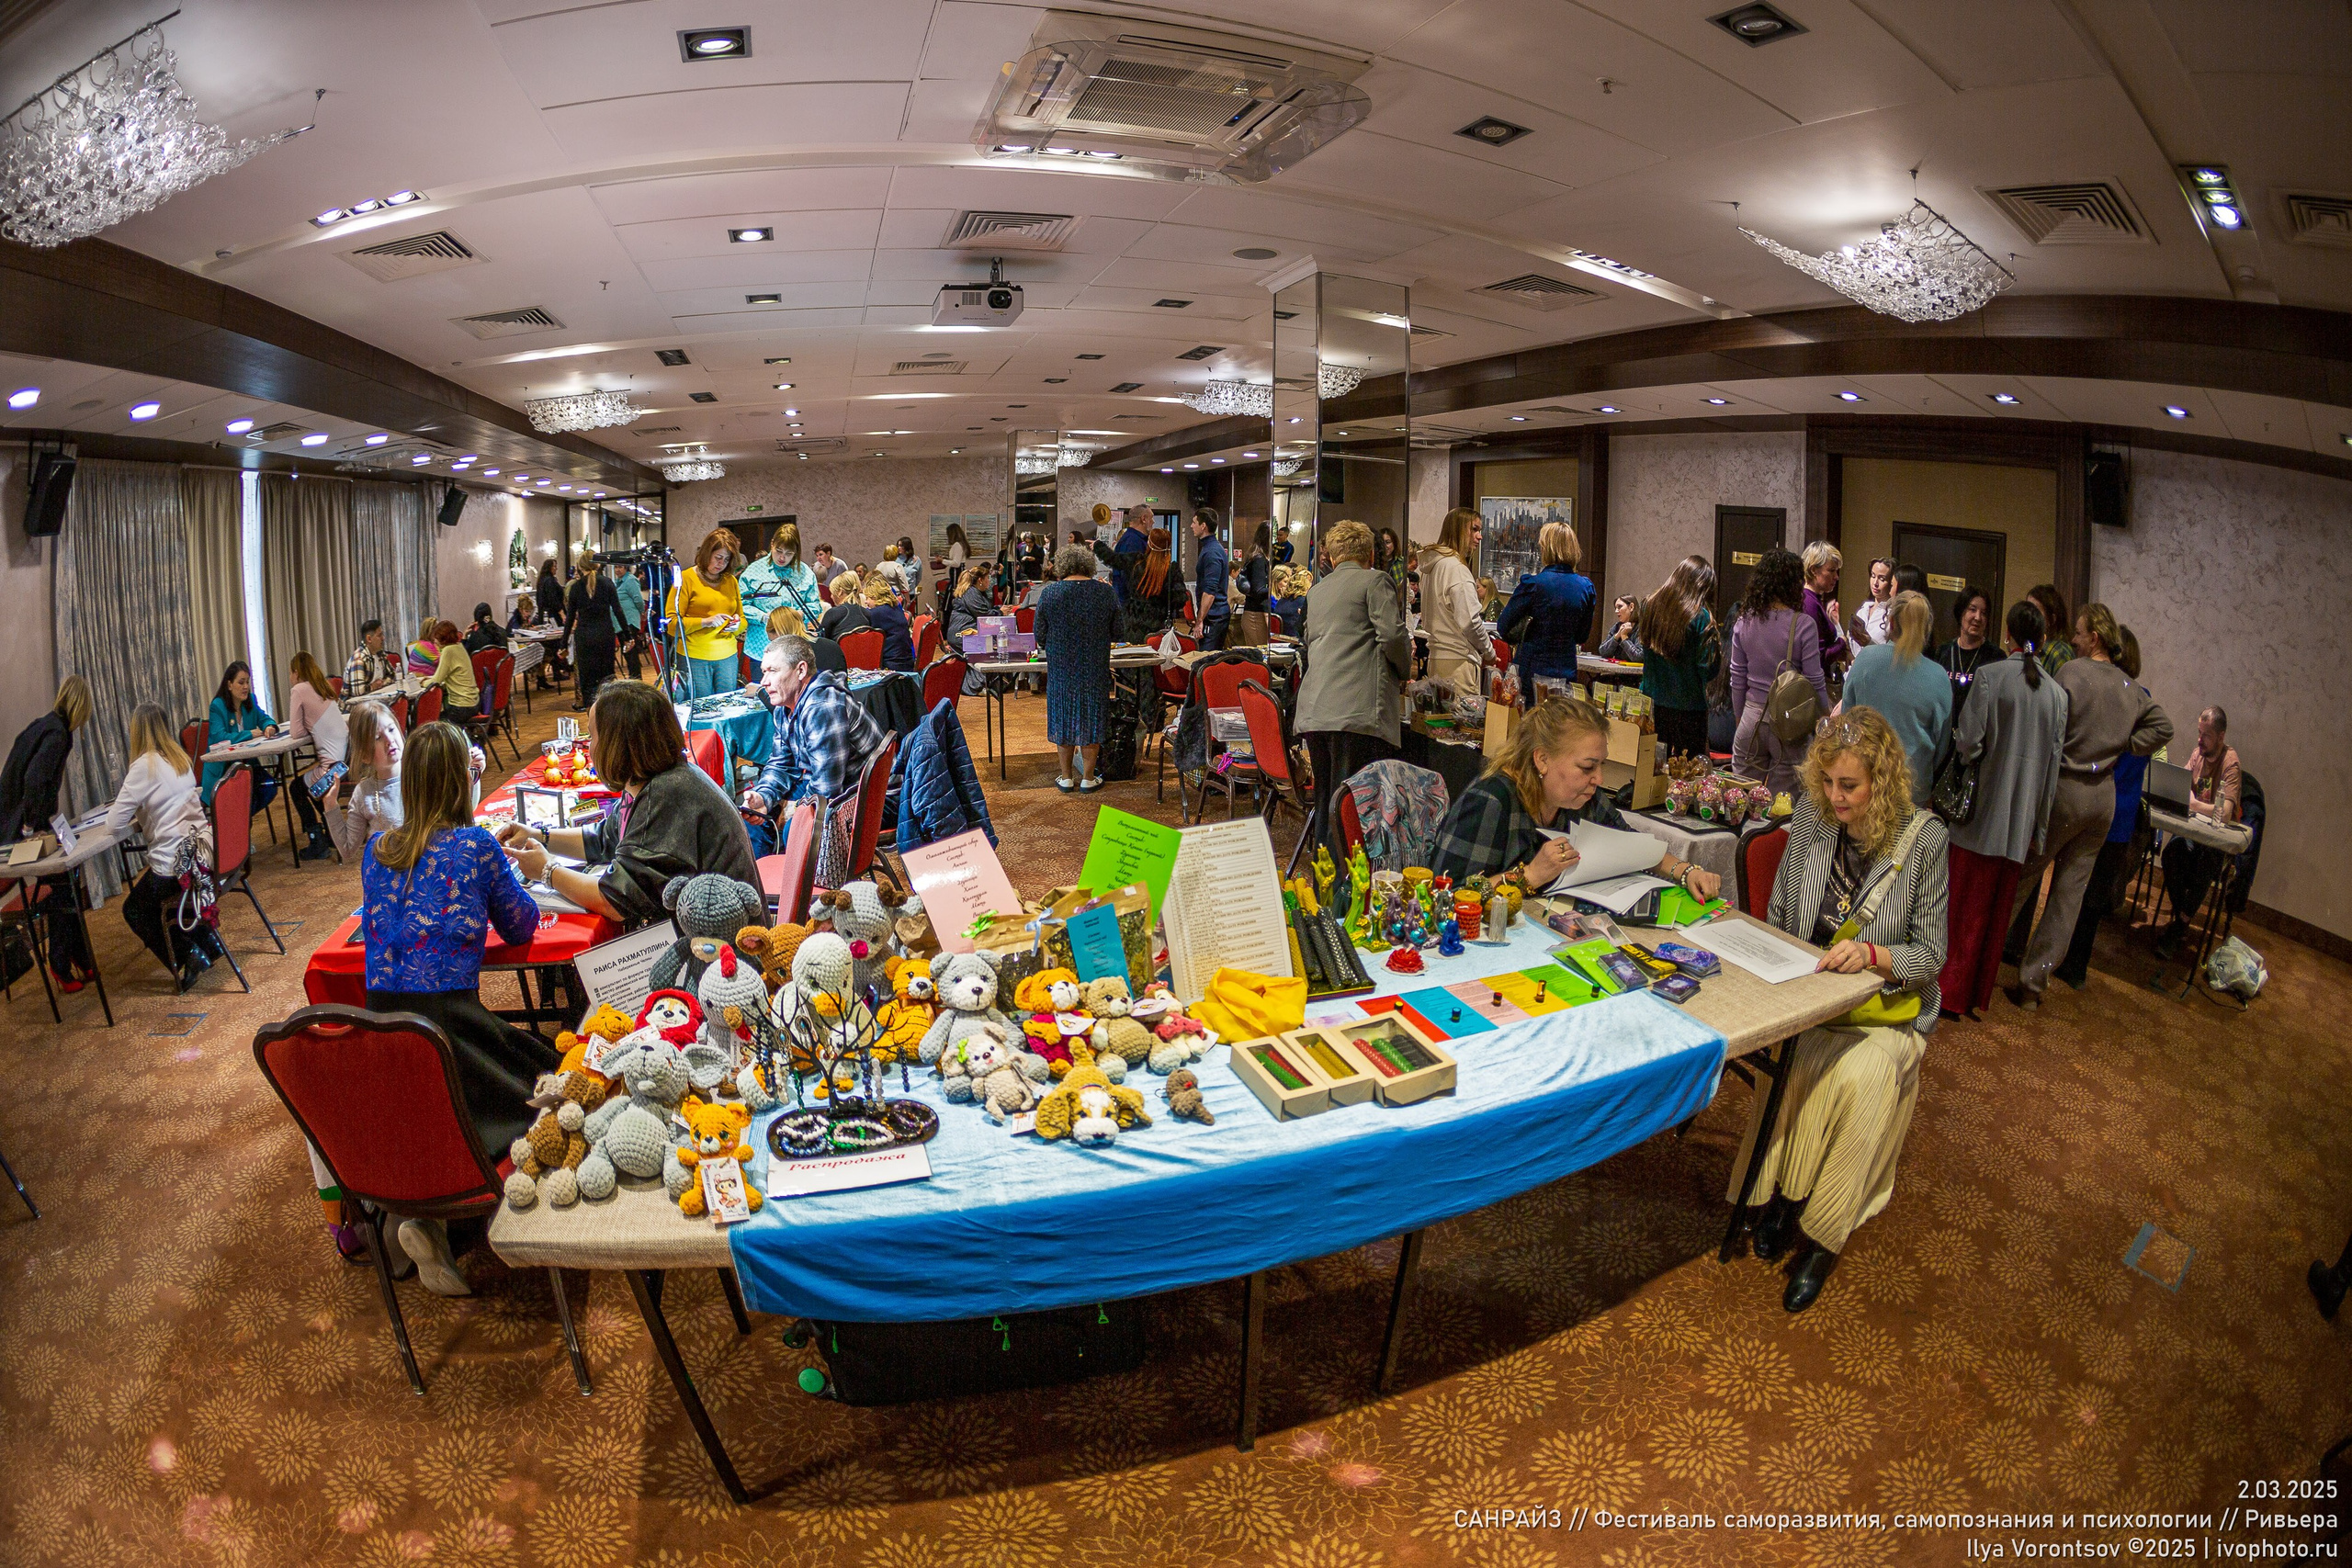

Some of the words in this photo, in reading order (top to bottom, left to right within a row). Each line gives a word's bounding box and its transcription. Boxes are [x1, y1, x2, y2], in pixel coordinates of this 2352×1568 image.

[594, 961, 618, 975] РАИСА
[617, 940, 671, 965] РАХМАТУЛЛИНА
[788, 1153, 906, 1171] Распродажа
